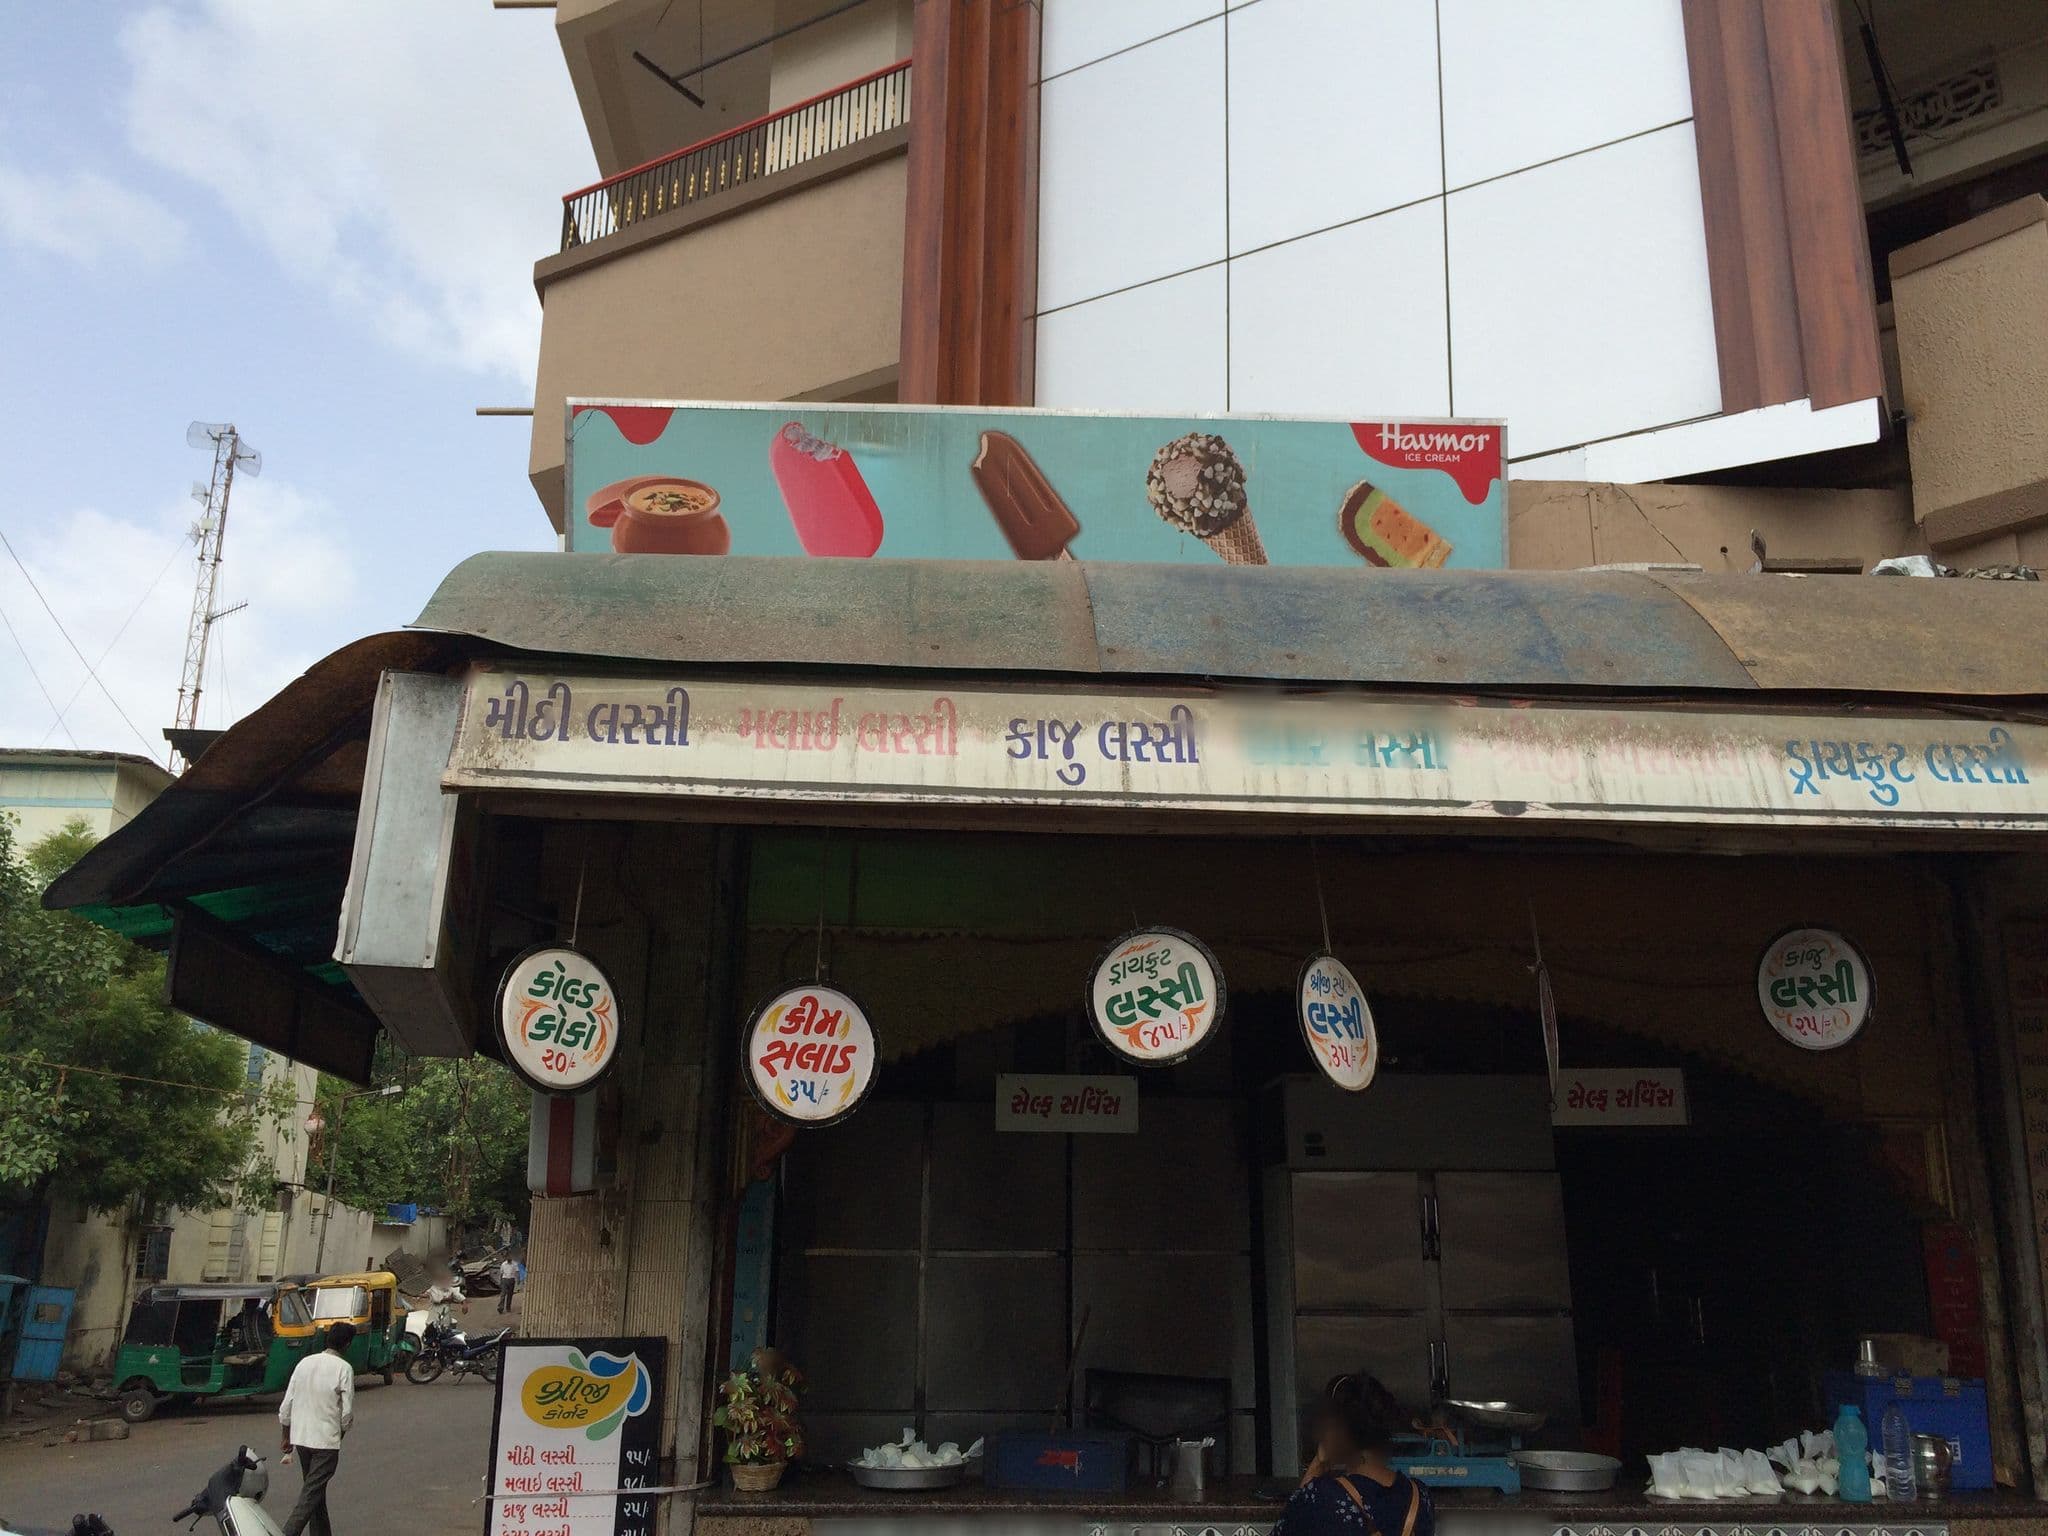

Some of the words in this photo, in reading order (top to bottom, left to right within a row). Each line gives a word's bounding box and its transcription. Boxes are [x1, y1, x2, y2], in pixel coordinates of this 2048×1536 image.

[1376, 424, 1490, 452] Havmor
[1405, 453, 1421, 462] ICE
[1425, 454, 1460, 462] CREAM
[587, 687, 690, 746] લસ્સી
[858, 697, 959, 755] લસ્સી
[1005, 718, 1086, 786] કાજુ
[1097, 704, 1200, 763] લસ્સી
[1785, 948, 1826, 970] કાજુ
[528, 960, 600, 1008] કોલ્ડ
[1105, 962, 1204, 1026] લસ્સી
[1770, 960, 1858, 1009] લસ્સી
[528, 1004, 597, 1051] કોકો
[1308, 997, 1365, 1039] લસ્સી
[759, 1040, 857, 1078] સલાડ
[535, 1376, 610, 1405] શ્રીજી
[507, 1445, 535, 1466] મીઠી
[541, 1444, 576, 1465] લસ્સી
[546, 1471, 583, 1492] લસ્સી
[502, 1503, 527, 1524] કાજુ
[532, 1496, 569, 1518] લસ્સી
